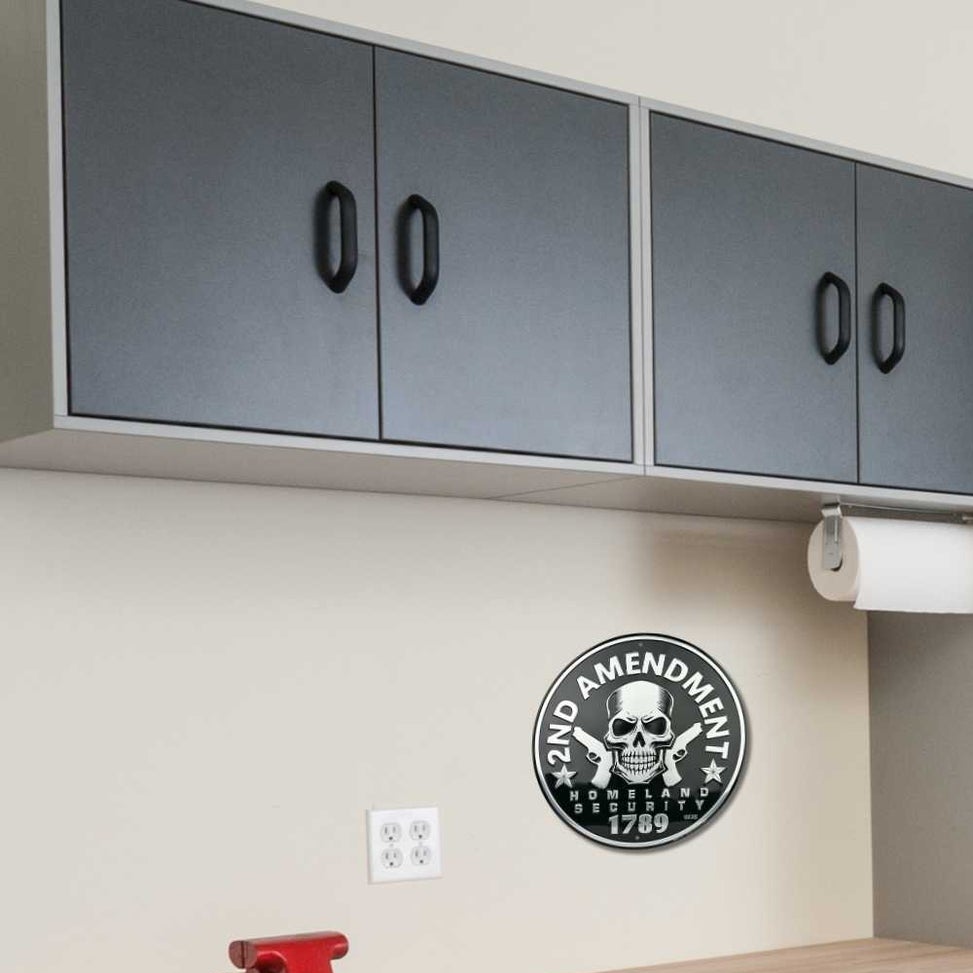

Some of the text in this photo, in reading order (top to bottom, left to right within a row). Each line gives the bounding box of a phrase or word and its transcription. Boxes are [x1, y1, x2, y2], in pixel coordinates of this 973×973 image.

[547, 652, 731, 766] 2ND AMENDMENT
[569, 787, 709, 801] HOMELAND
[574, 801, 705, 813] SECURITY
[608, 813, 669, 834] 1789
